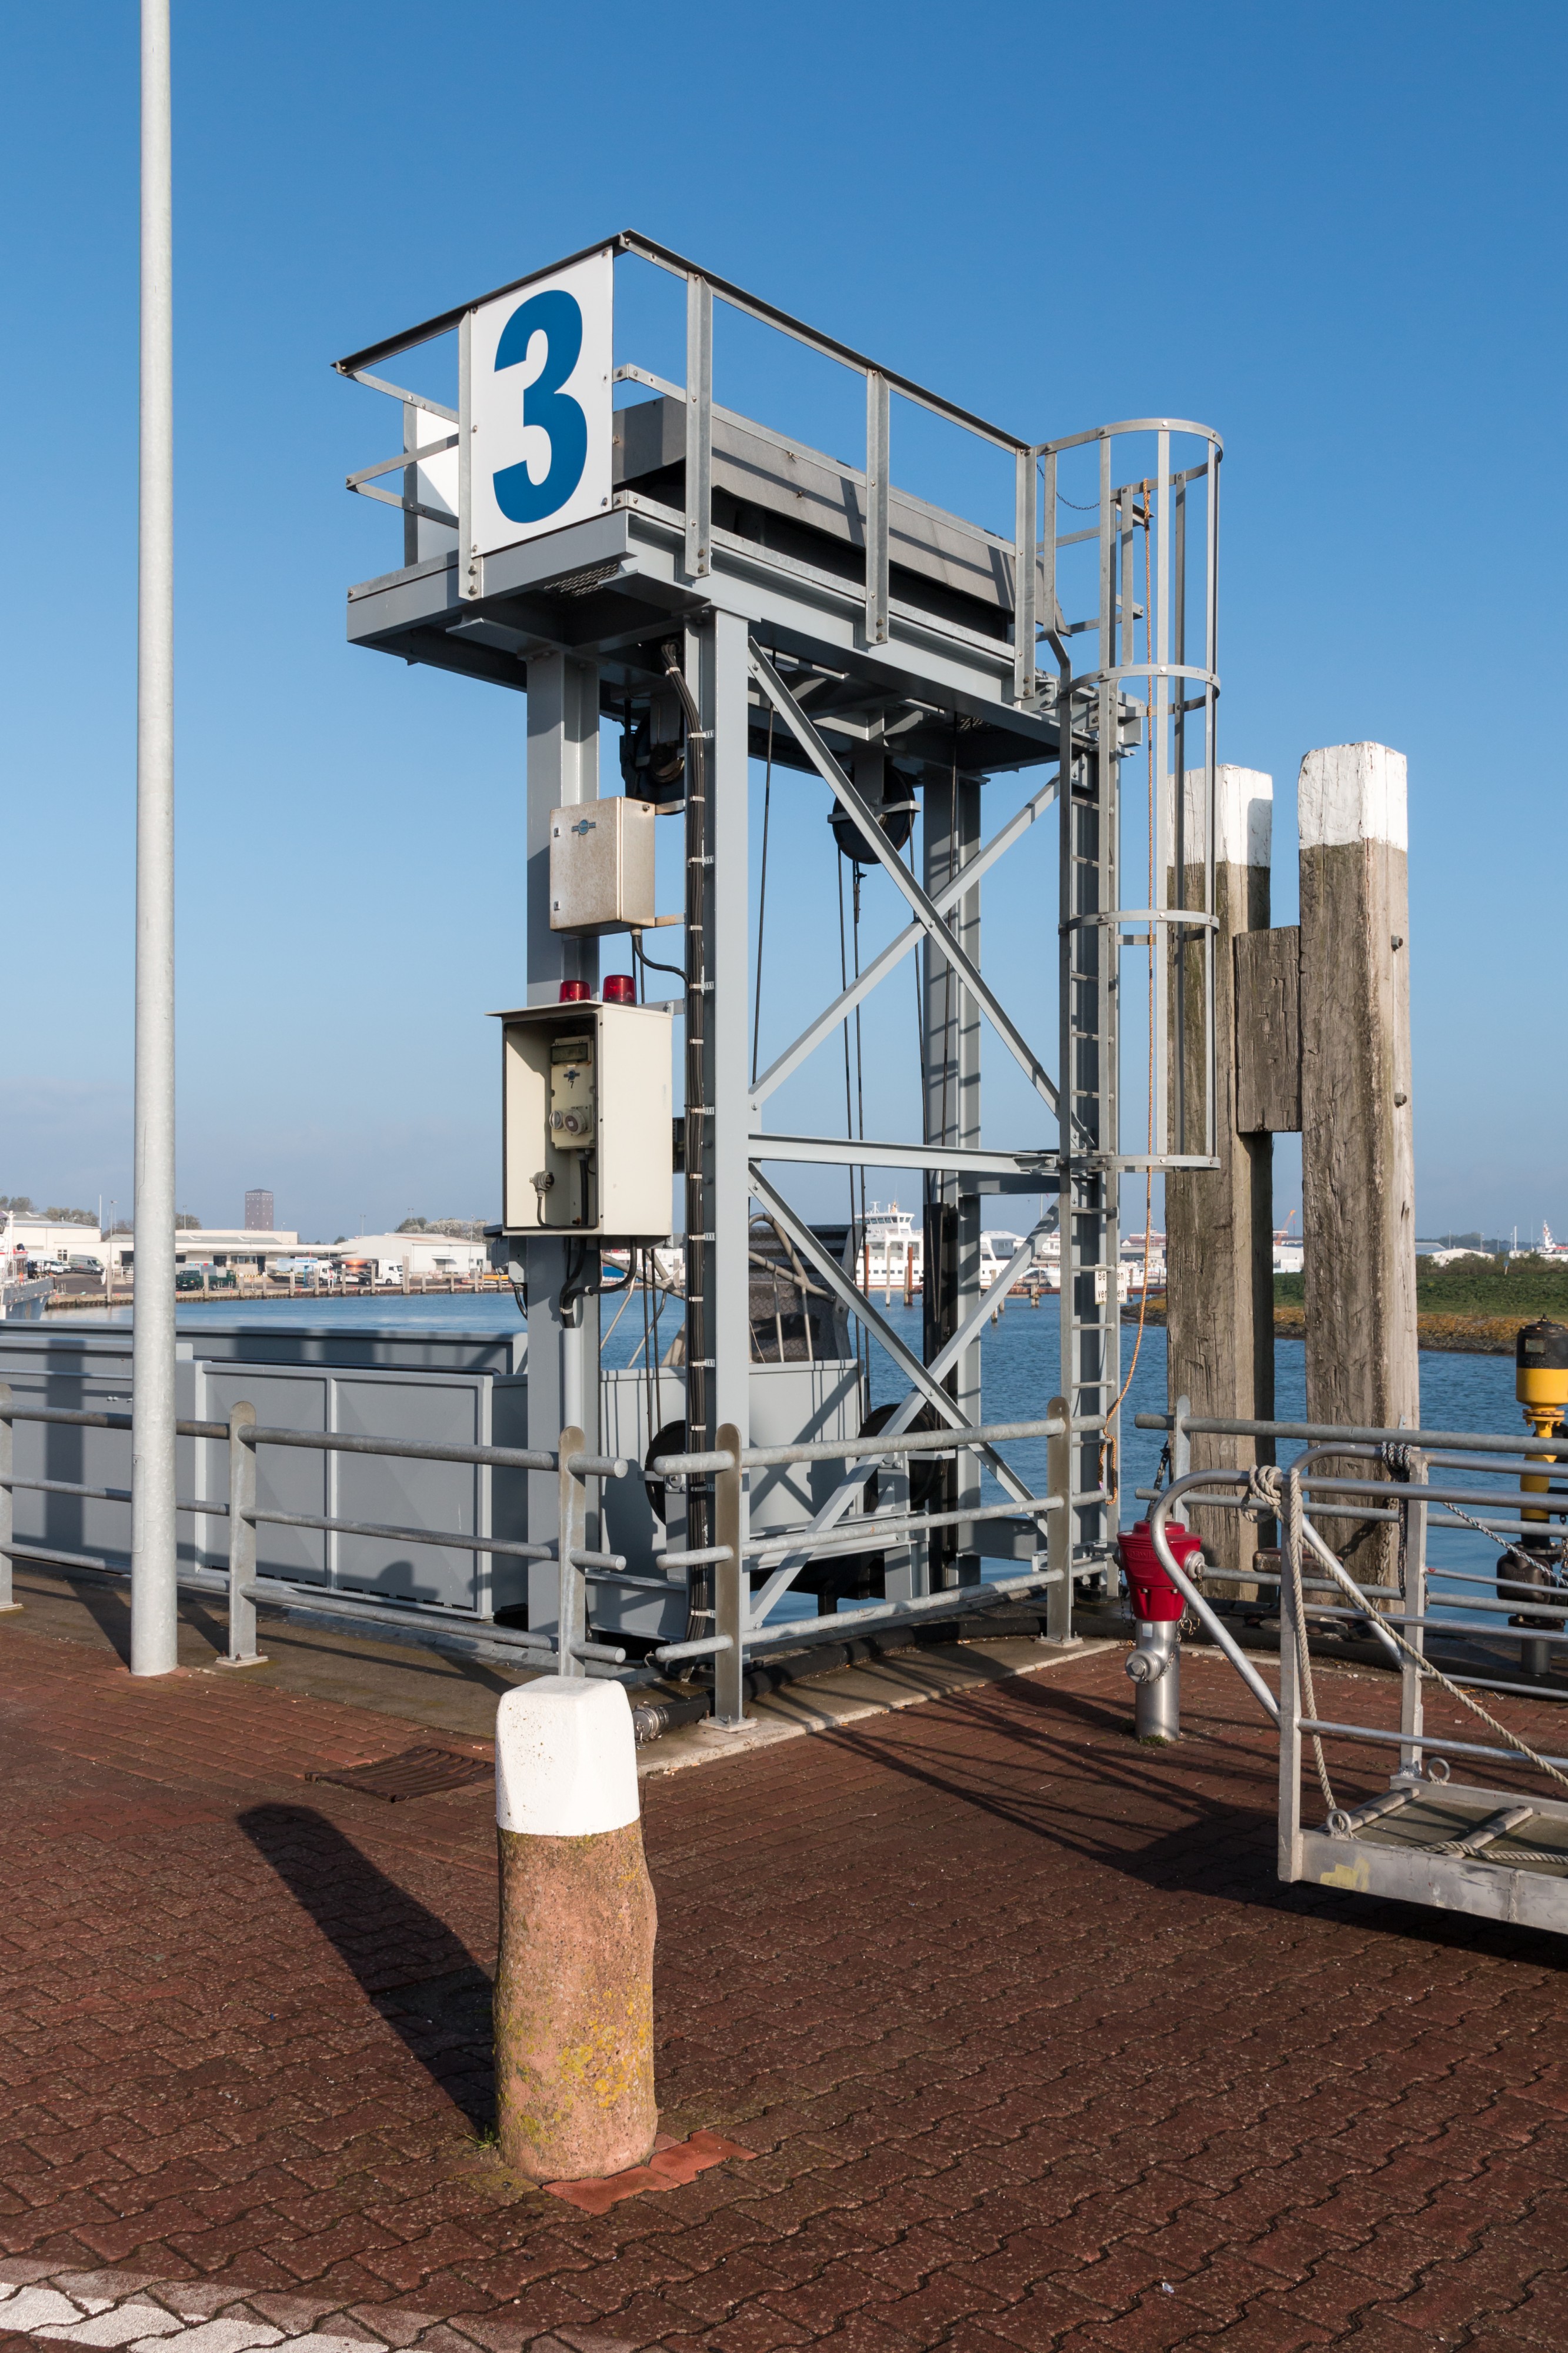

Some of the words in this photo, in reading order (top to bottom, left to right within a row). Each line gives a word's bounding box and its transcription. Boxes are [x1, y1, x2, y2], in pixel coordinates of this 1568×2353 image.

[493, 290, 588, 523] 3
[569, 1081, 575, 1089] 7
[1098, 1271, 1124, 1281] Been
[1097, 1289, 1125, 1298] veren
